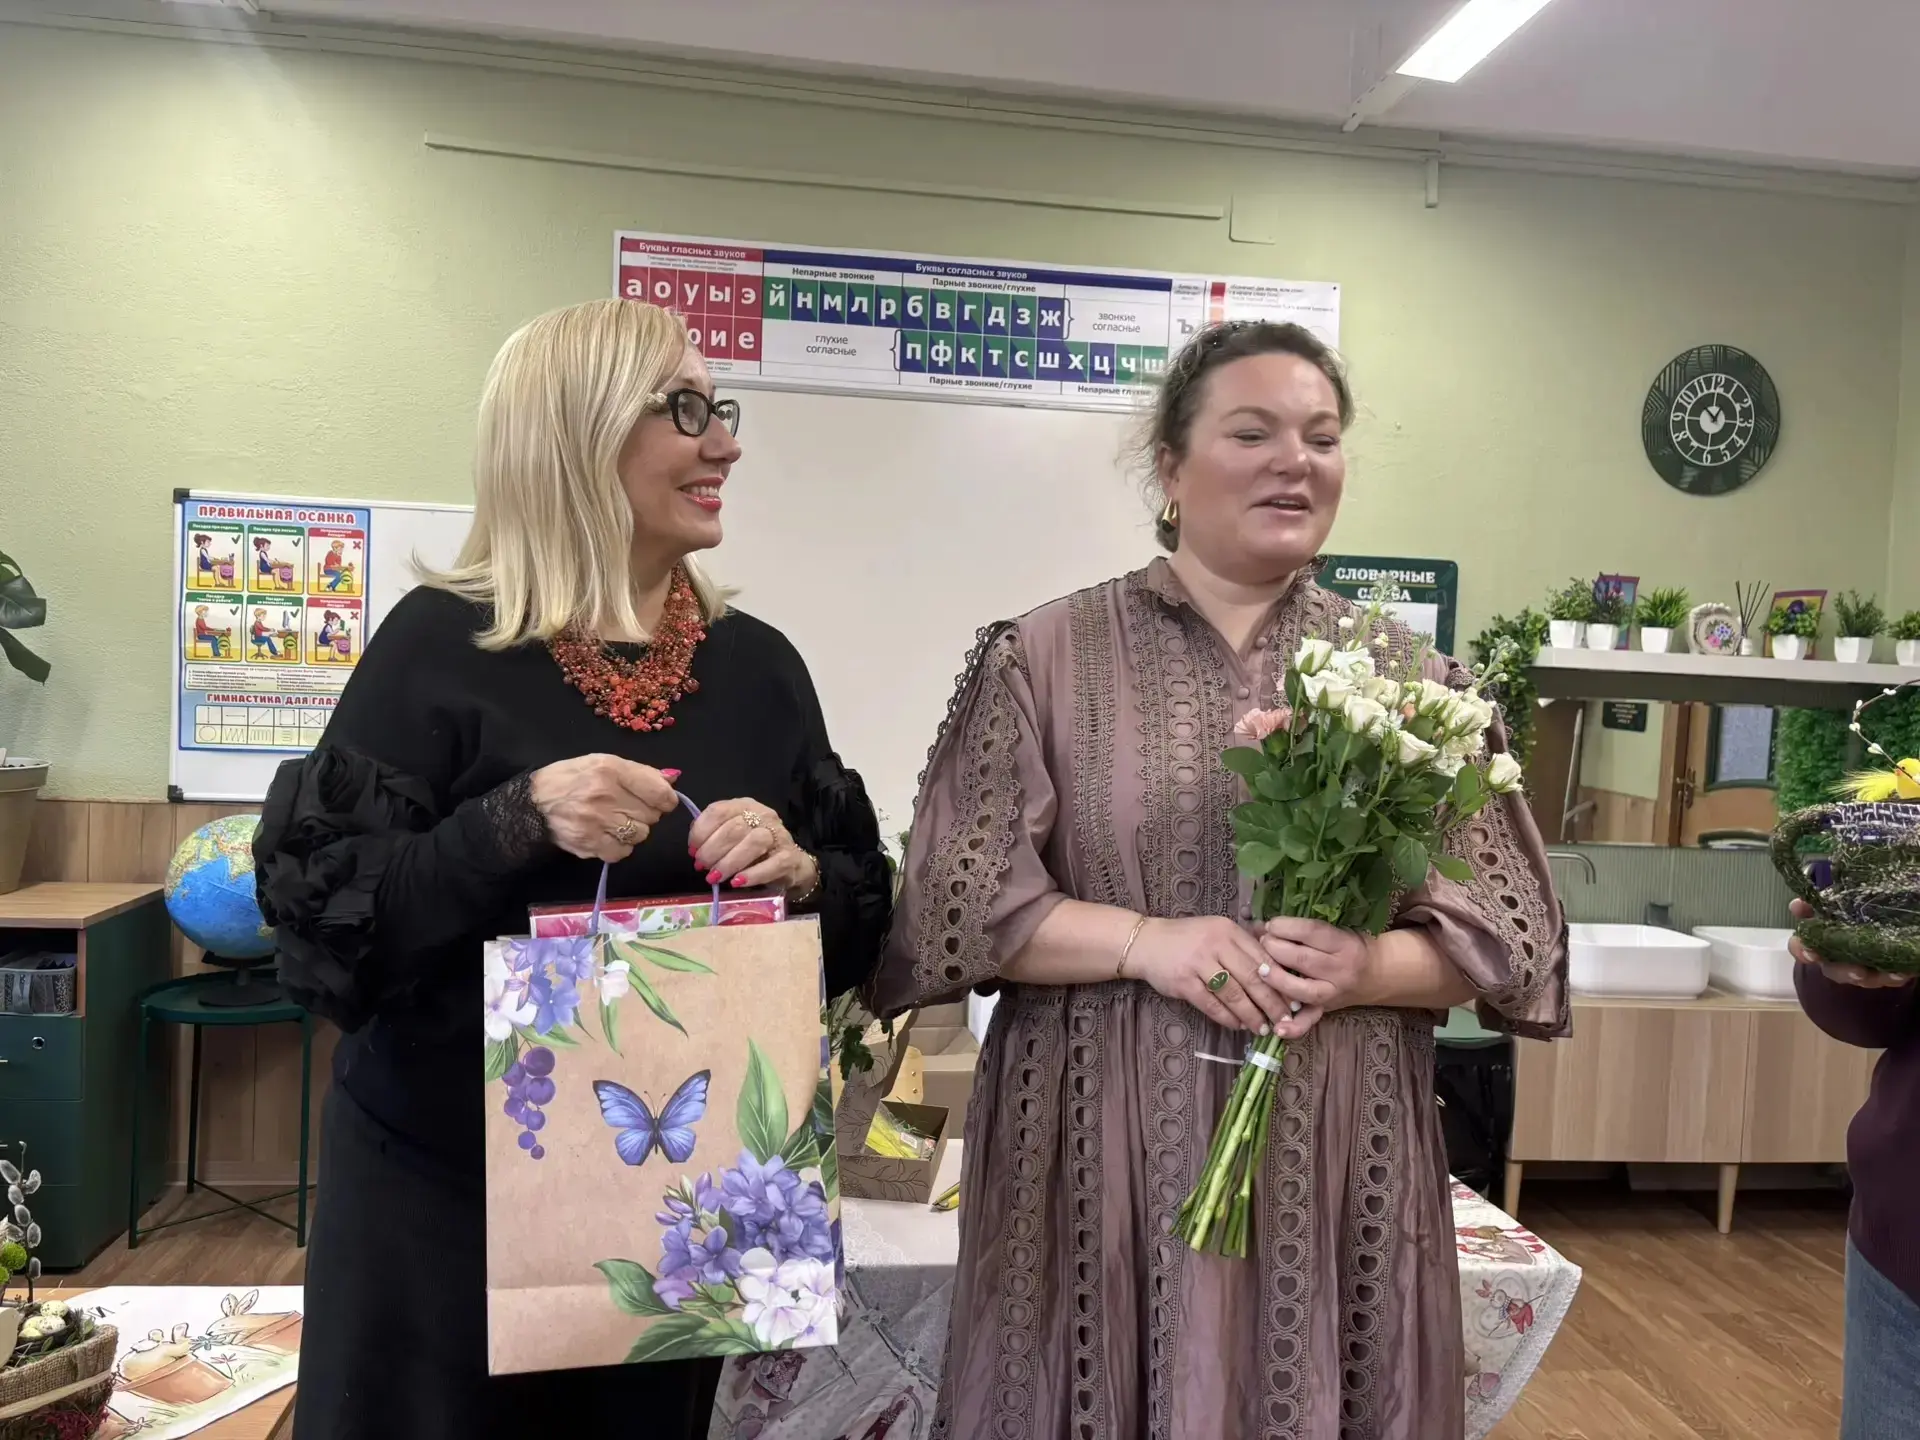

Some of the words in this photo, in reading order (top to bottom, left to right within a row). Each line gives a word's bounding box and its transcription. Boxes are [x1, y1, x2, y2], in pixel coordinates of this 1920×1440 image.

[639, 242, 670, 254] Буквы
[671, 247, 712, 257] гласных
[713, 250, 746, 259] звуков
[792, 267, 837, 278] Непарные
[838, 271, 875, 280] звонкие
[915, 263, 945, 275] Буквы
[946, 266, 995, 277] согласных
[996, 271, 1028, 281] звуков
[626, 279, 642, 297] а
[654, 281, 671, 299] о
[683, 283, 700, 306] у
[709, 285, 731, 303] ы
[741, 287, 756, 305] э
[932, 277, 966, 288] Парные
[967, 280, 1037, 293] звонкие/глухие
[769, 283, 785, 307] й
[796, 291, 813, 309] н
[823, 294, 842, 312] м
[850, 296, 868, 313] л
[880, 298, 897, 320] р
[907, 295, 923, 318] б
[935, 302, 951, 319] в
[963, 304, 977, 321] г
[987, 306, 1006, 327] д
[1016, 308, 1031, 325] з
[1040, 309, 1062, 327] ж
[1098, 313, 1136, 322] звонкие
[1092, 323, 1141, 334] согласные
[710, 329, 727, 347] и
[738, 331, 755, 349] е
[815, 334, 849, 345] глухие
[806, 344, 857, 356] согласные
[906, 343, 922, 360] п
[930, 339, 952, 367] ф
[961, 347, 976, 364] к
[988, 349, 1003, 366] т
[1014, 350, 1029, 367] с
[1038, 352, 1060, 369] ш
[1067, 354, 1084, 370] х
[1093, 356, 1110, 375] ц
[1121, 357, 1136, 373] ч
[929, 376, 963, 386] Парные
[964, 379, 1033, 390] звонкие/глухие
[1077, 386, 1120, 395] Непарные
[1693, 378, 1707, 396] 11
[1710, 375, 1725, 393] 12
[1727, 382, 1739, 398] 1
[1678, 390, 1695, 407] 10
[1737, 397, 1751, 410] 2
[1672, 412, 1687, 421] 9
[1738, 418, 1753, 427] 3
[1673, 430, 1689, 442] 8
[1733, 434, 1745, 447] 4
[1687, 441, 1698, 457] 7
[1702, 449, 1711, 464] 6
[1720, 444, 1731, 462] 5
[199, 506, 293, 521] ПРАВИЛЬНАЯ
[298, 511, 355, 524] ОСАНКА
[207, 693, 282, 704] ГИМНАСТИКА
[285, 697, 309, 706] ДЛЯ
[311, 697, 339, 706] ГЛАЗ
